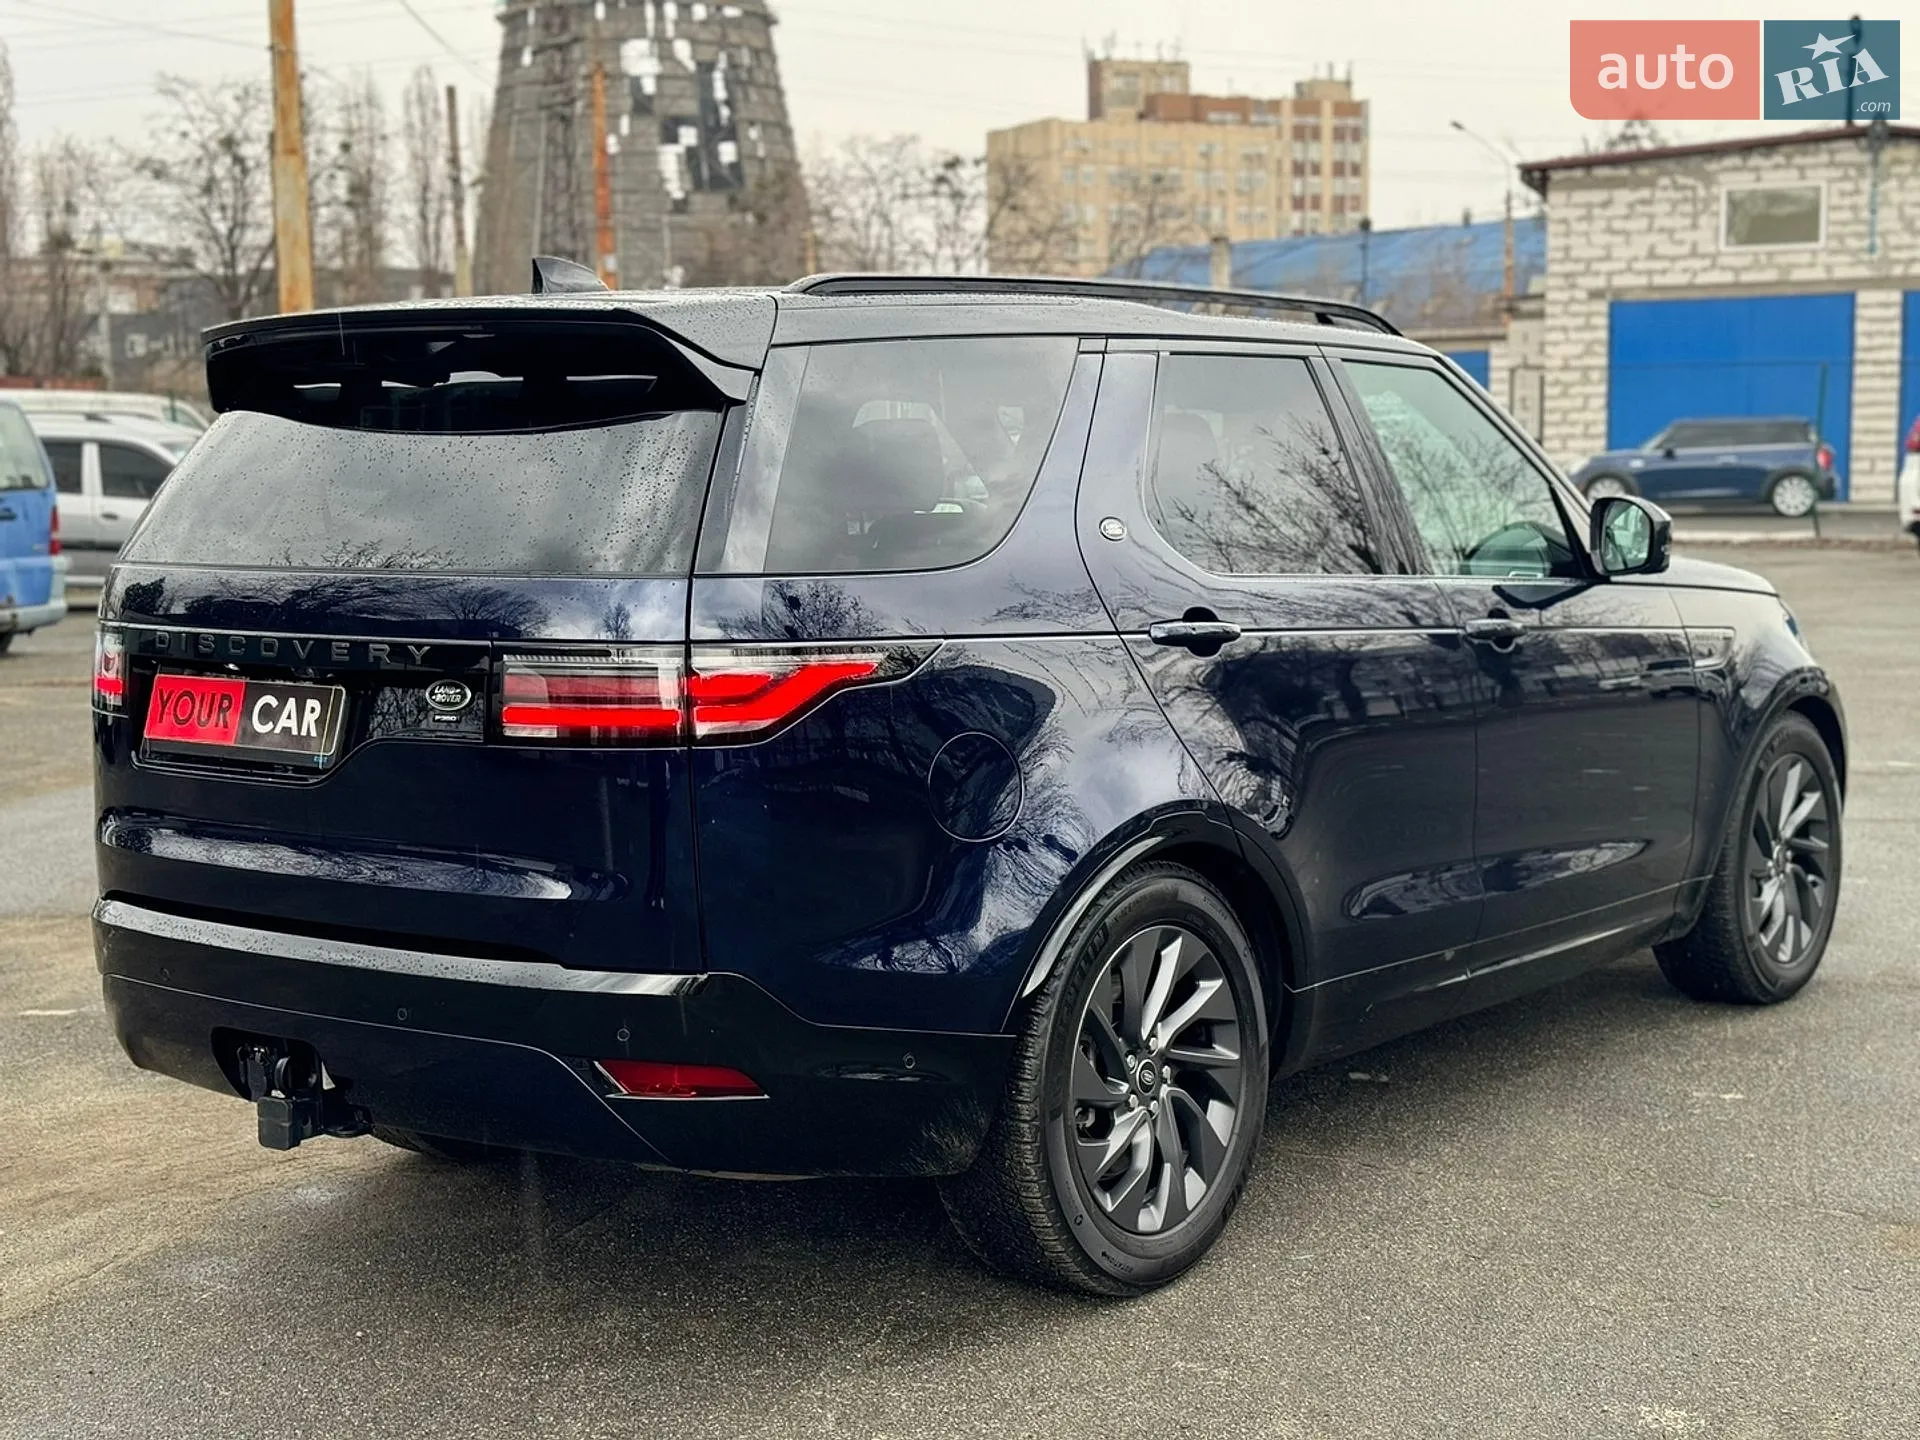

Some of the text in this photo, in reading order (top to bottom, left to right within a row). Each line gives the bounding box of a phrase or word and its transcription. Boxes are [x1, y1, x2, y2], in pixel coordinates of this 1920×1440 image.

[154, 631, 431, 665] DISCOVERY
[157, 688, 322, 737] YOUR CAR
